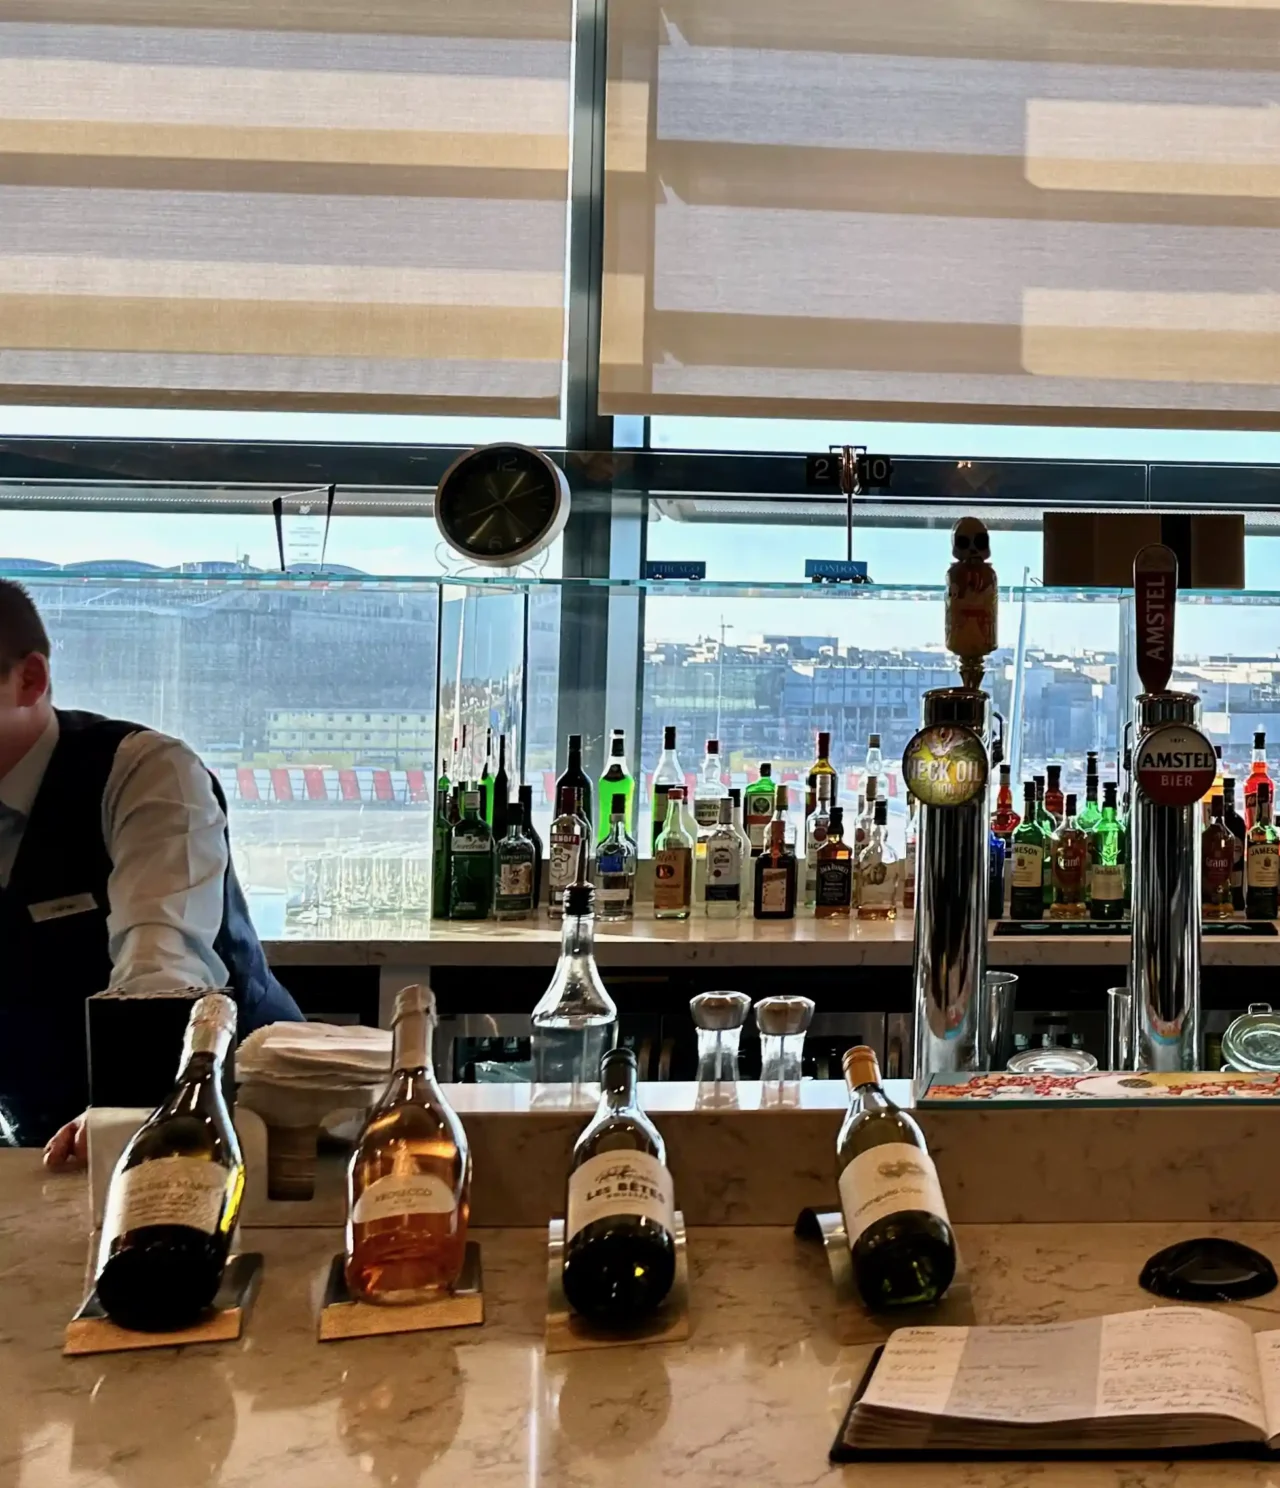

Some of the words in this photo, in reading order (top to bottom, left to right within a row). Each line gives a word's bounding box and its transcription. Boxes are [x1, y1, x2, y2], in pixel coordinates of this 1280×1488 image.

[815, 459, 829, 479] 2
[862, 459, 887, 479] 10
[652, 563, 700, 574] CHICAGO
[813, 563, 860, 574] LONDON
[1146, 575, 1166, 662] AMSTEL
[1141, 752, 1212, 769] AMSTEL
[956, 760, 982, 783] OIL
[1160, 774, 1193, 787] BIER
[586, 1186, 611, 1201] LES
